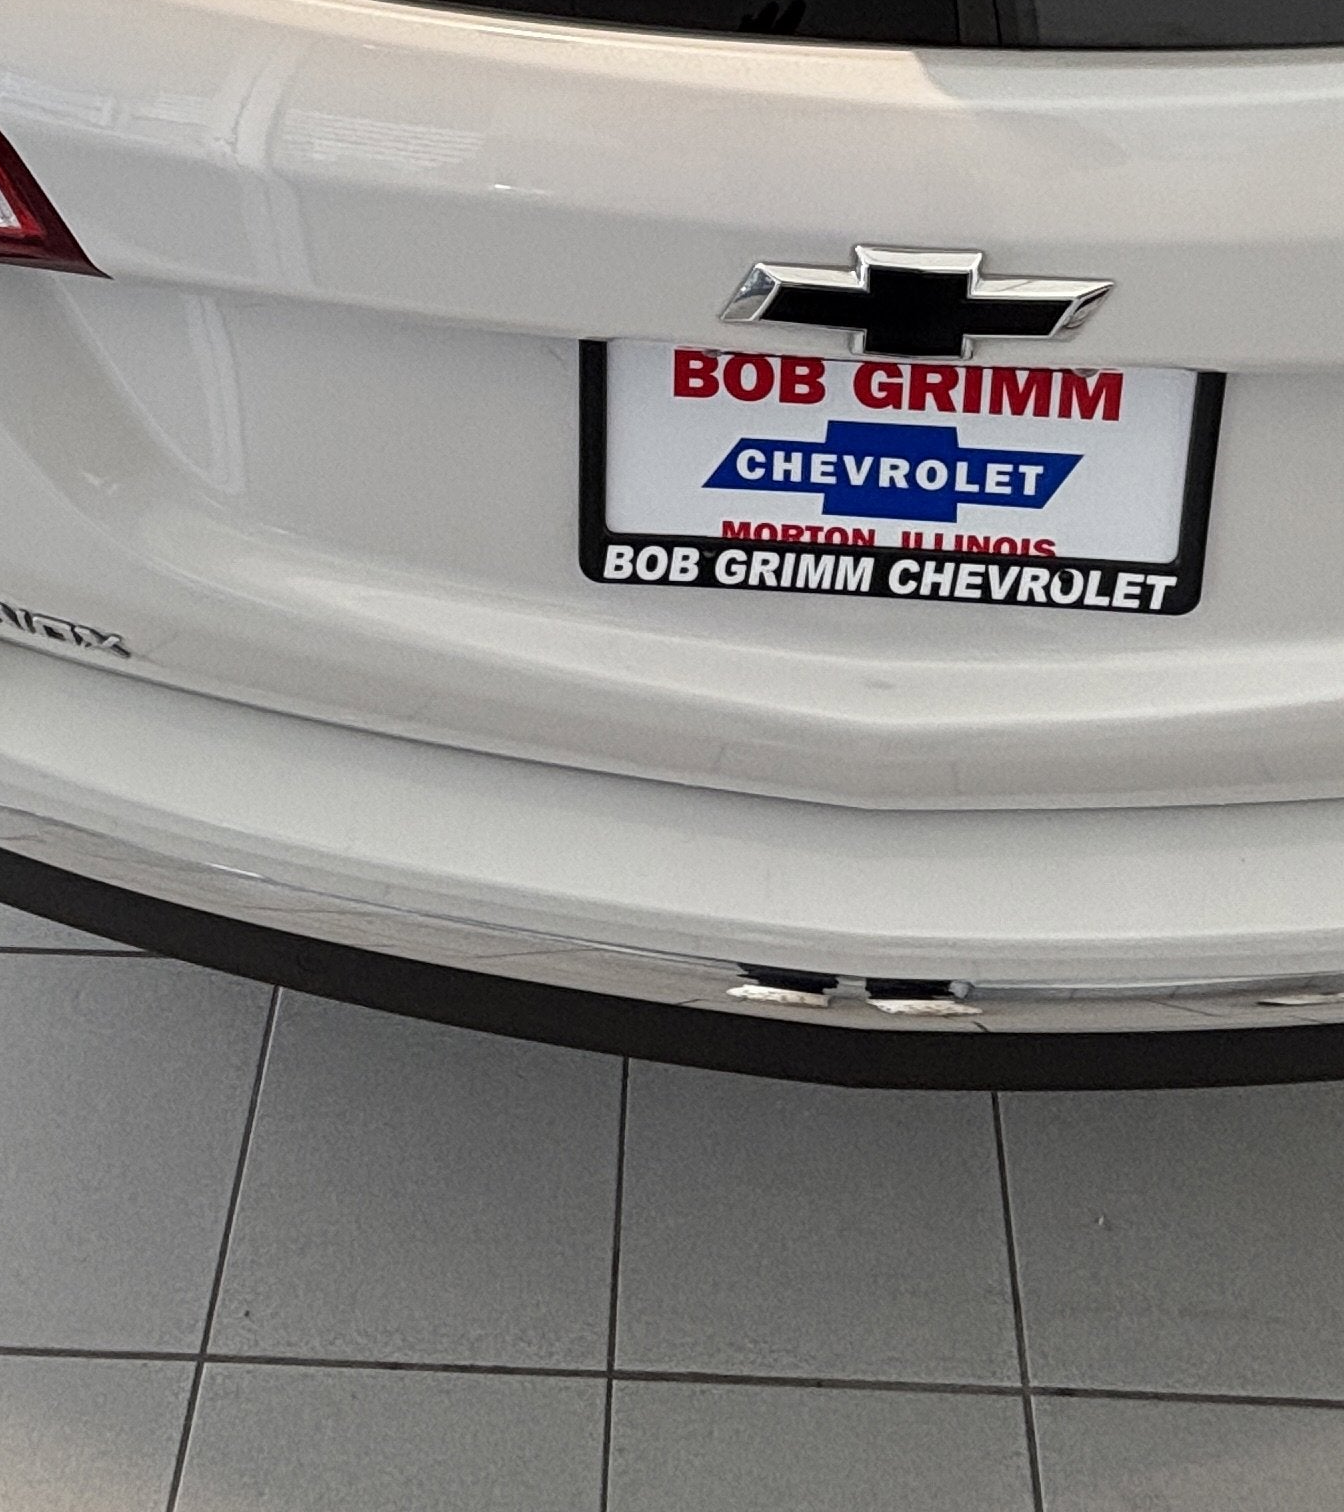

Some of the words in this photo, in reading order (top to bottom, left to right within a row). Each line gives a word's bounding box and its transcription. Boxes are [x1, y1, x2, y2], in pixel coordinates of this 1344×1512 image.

[673, 348, 826, 405] BOB
[852, 360, 1124, 421] GRIMM
[735, 448, 1045, 497] CHEVROLET
[602, 544, 700, 582] BOB
[714, 548, 875, 593] GRIMM
[887, 558, 1178, 610] CHEVROLET
